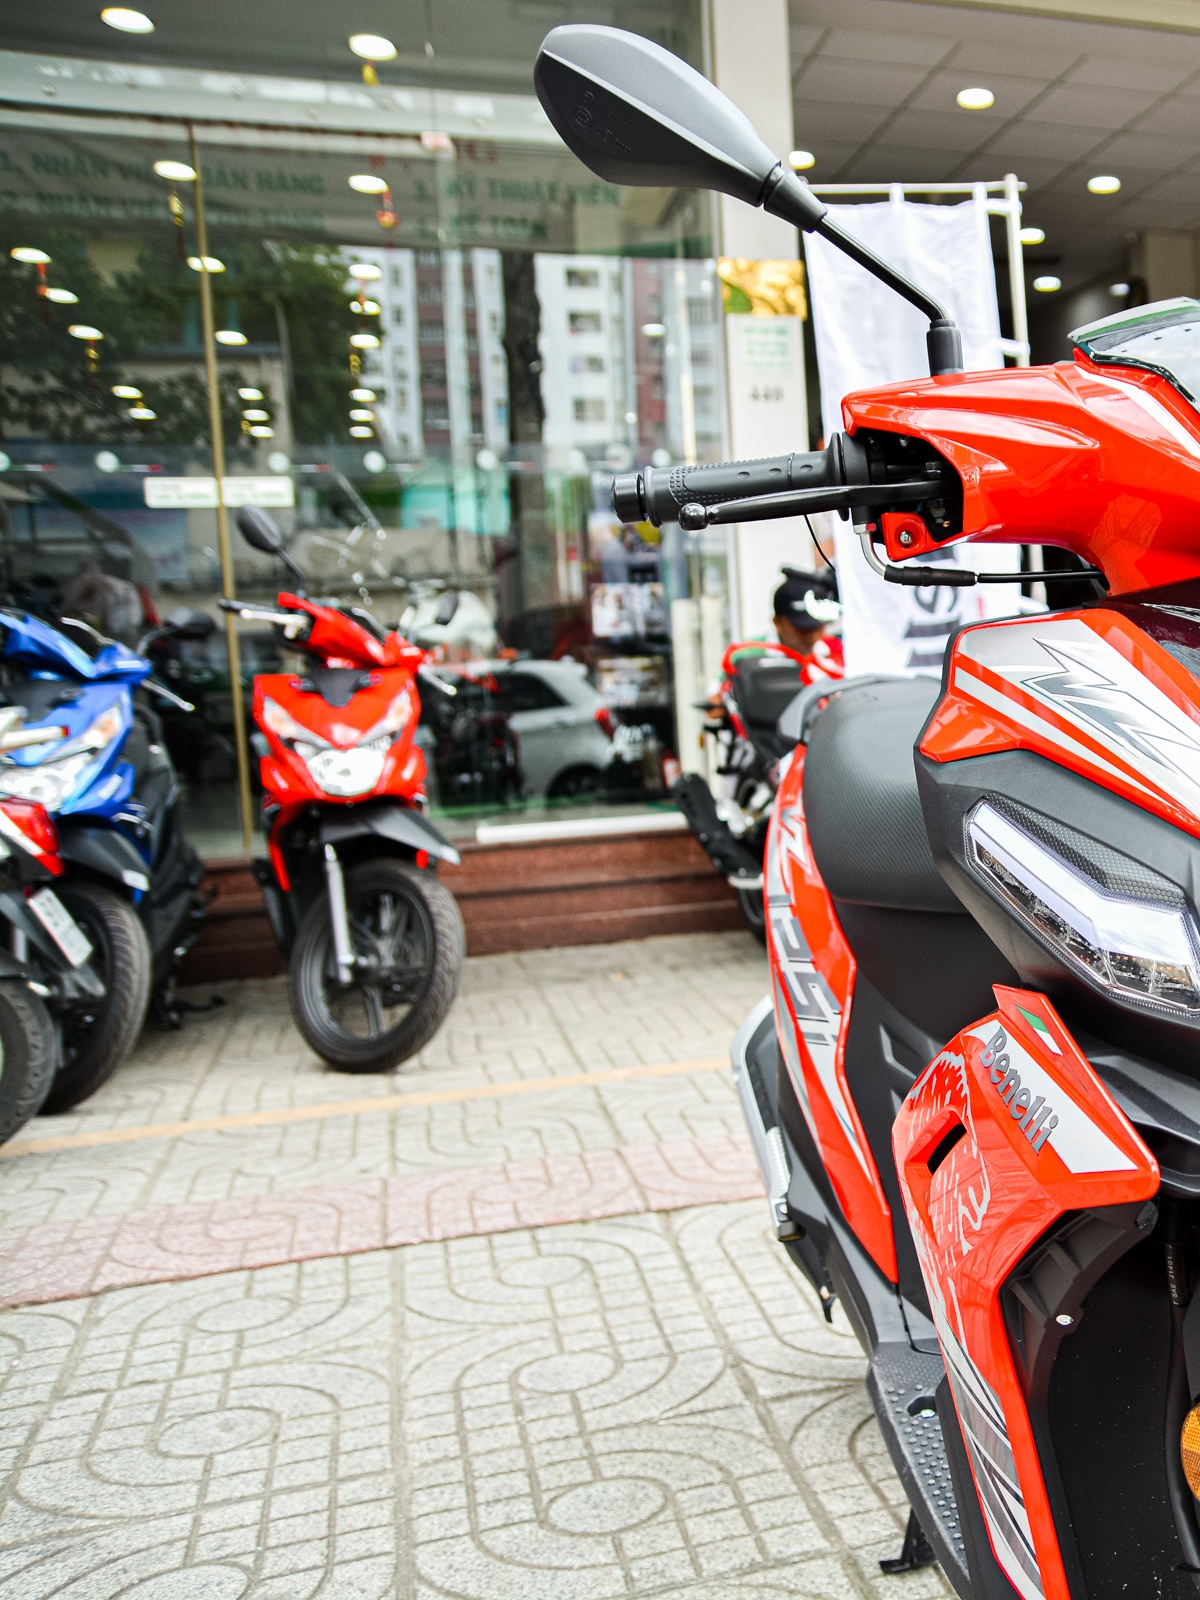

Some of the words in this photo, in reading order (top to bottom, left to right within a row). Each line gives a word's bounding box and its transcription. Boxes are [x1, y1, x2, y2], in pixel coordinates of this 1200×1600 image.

[979, 1025, 1060, 1155] Benelli
[1166, 1255, 1175, 1280] J1401
[1169, 1283, 1178, 1298] SAE
